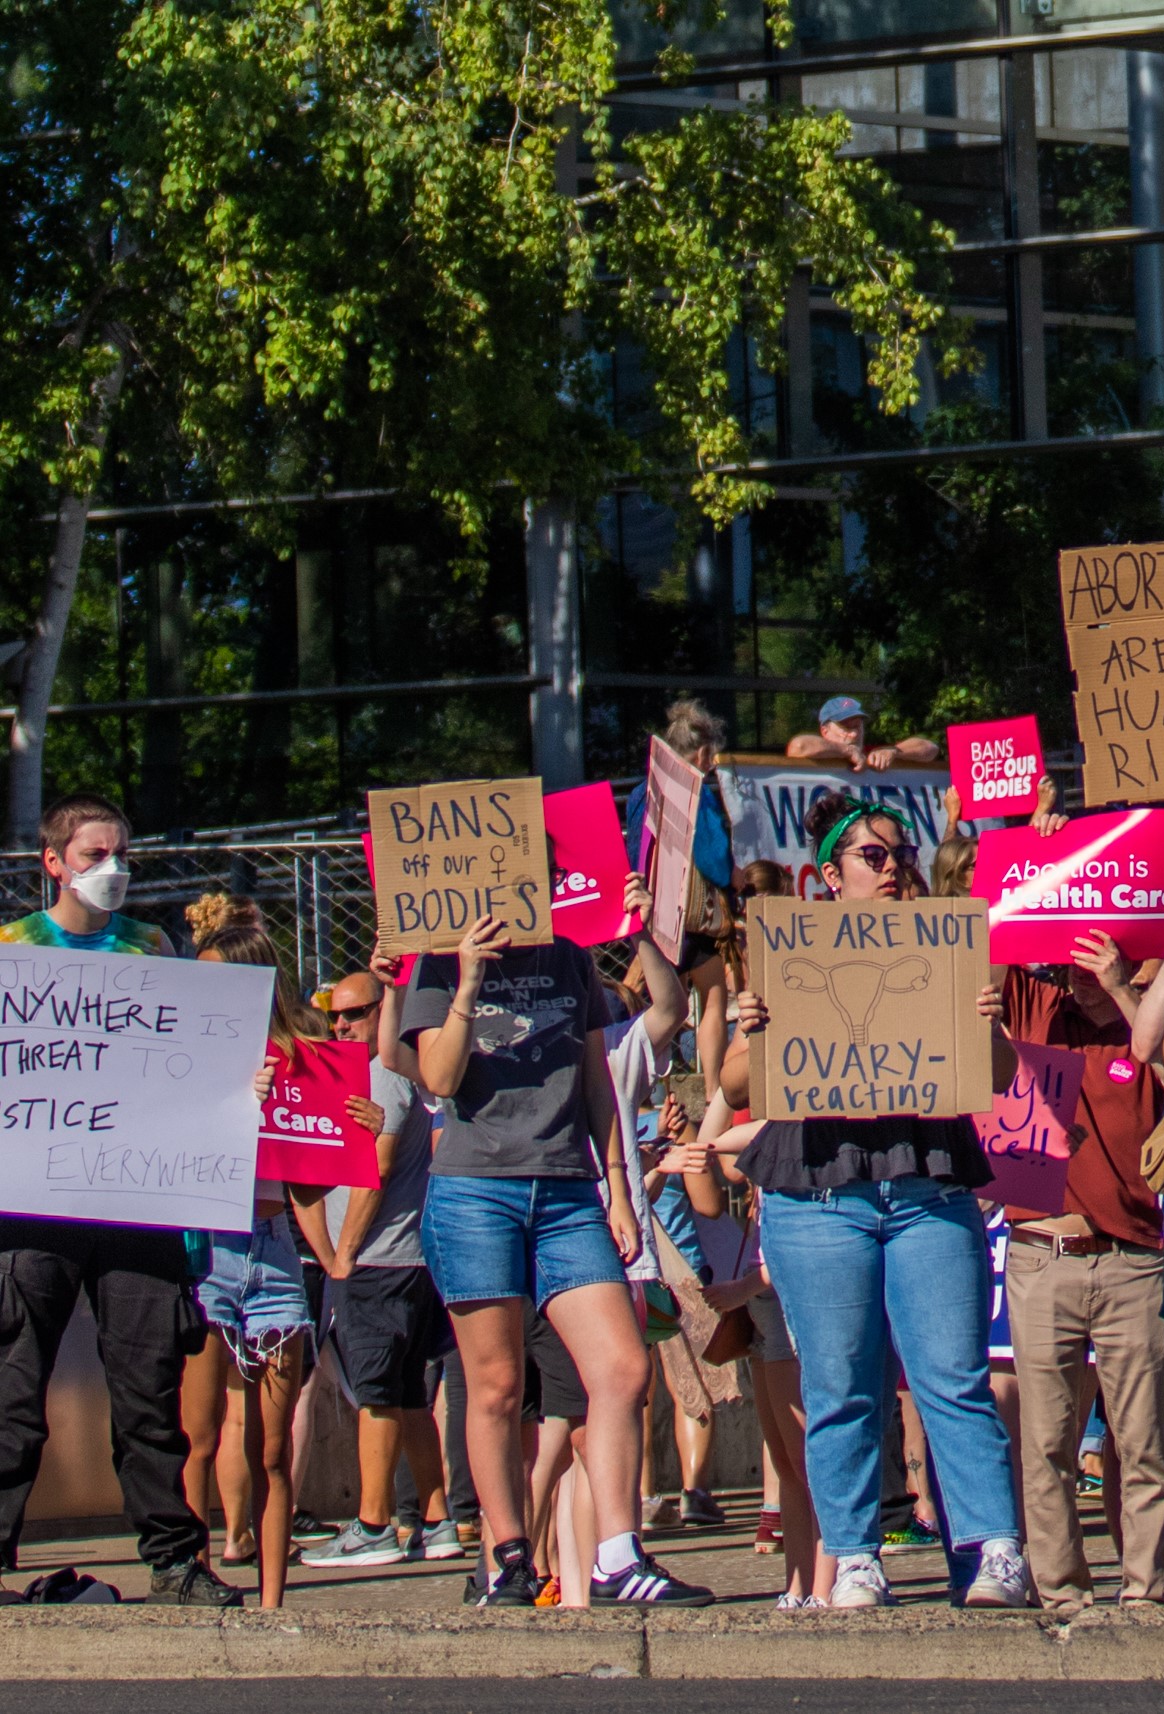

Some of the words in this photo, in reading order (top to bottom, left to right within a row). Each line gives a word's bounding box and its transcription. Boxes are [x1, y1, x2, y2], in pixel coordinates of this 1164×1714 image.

[971, 738, 1014, 762] BANS
[971, 761, 1002, 781] OFF
[1003, 755, 1037, 777] OUR
[972, 776, 1031, 801] BODIES
[390, 792, 515, 844] BANS
[402, 854, 430, 878] off
[1129, 854, 1148, 879] is
[394, 882, 538, 933] BODIES
[1001, 883, 1102, 910] Health
[757, 913, 818, 952] WE
[834, 913, 901, 950] ARE
[915, 913, 983, 950] NOT
[483, 976, 554, 993] DAZED
[201, 1014, 241, 1038] IS
[0, 1039, 110, 1076] THREAT
[132, 1048, 193, 1079] TO
[782, 1037, 946, 1083] OVARY-
[284, 1080, 302, 1103] is
[785, 1080, 939, 1113] reacting
[272, 1106, 342, 1135] Care.
[46, 1142, 251, 1187] EVERYWHERE
